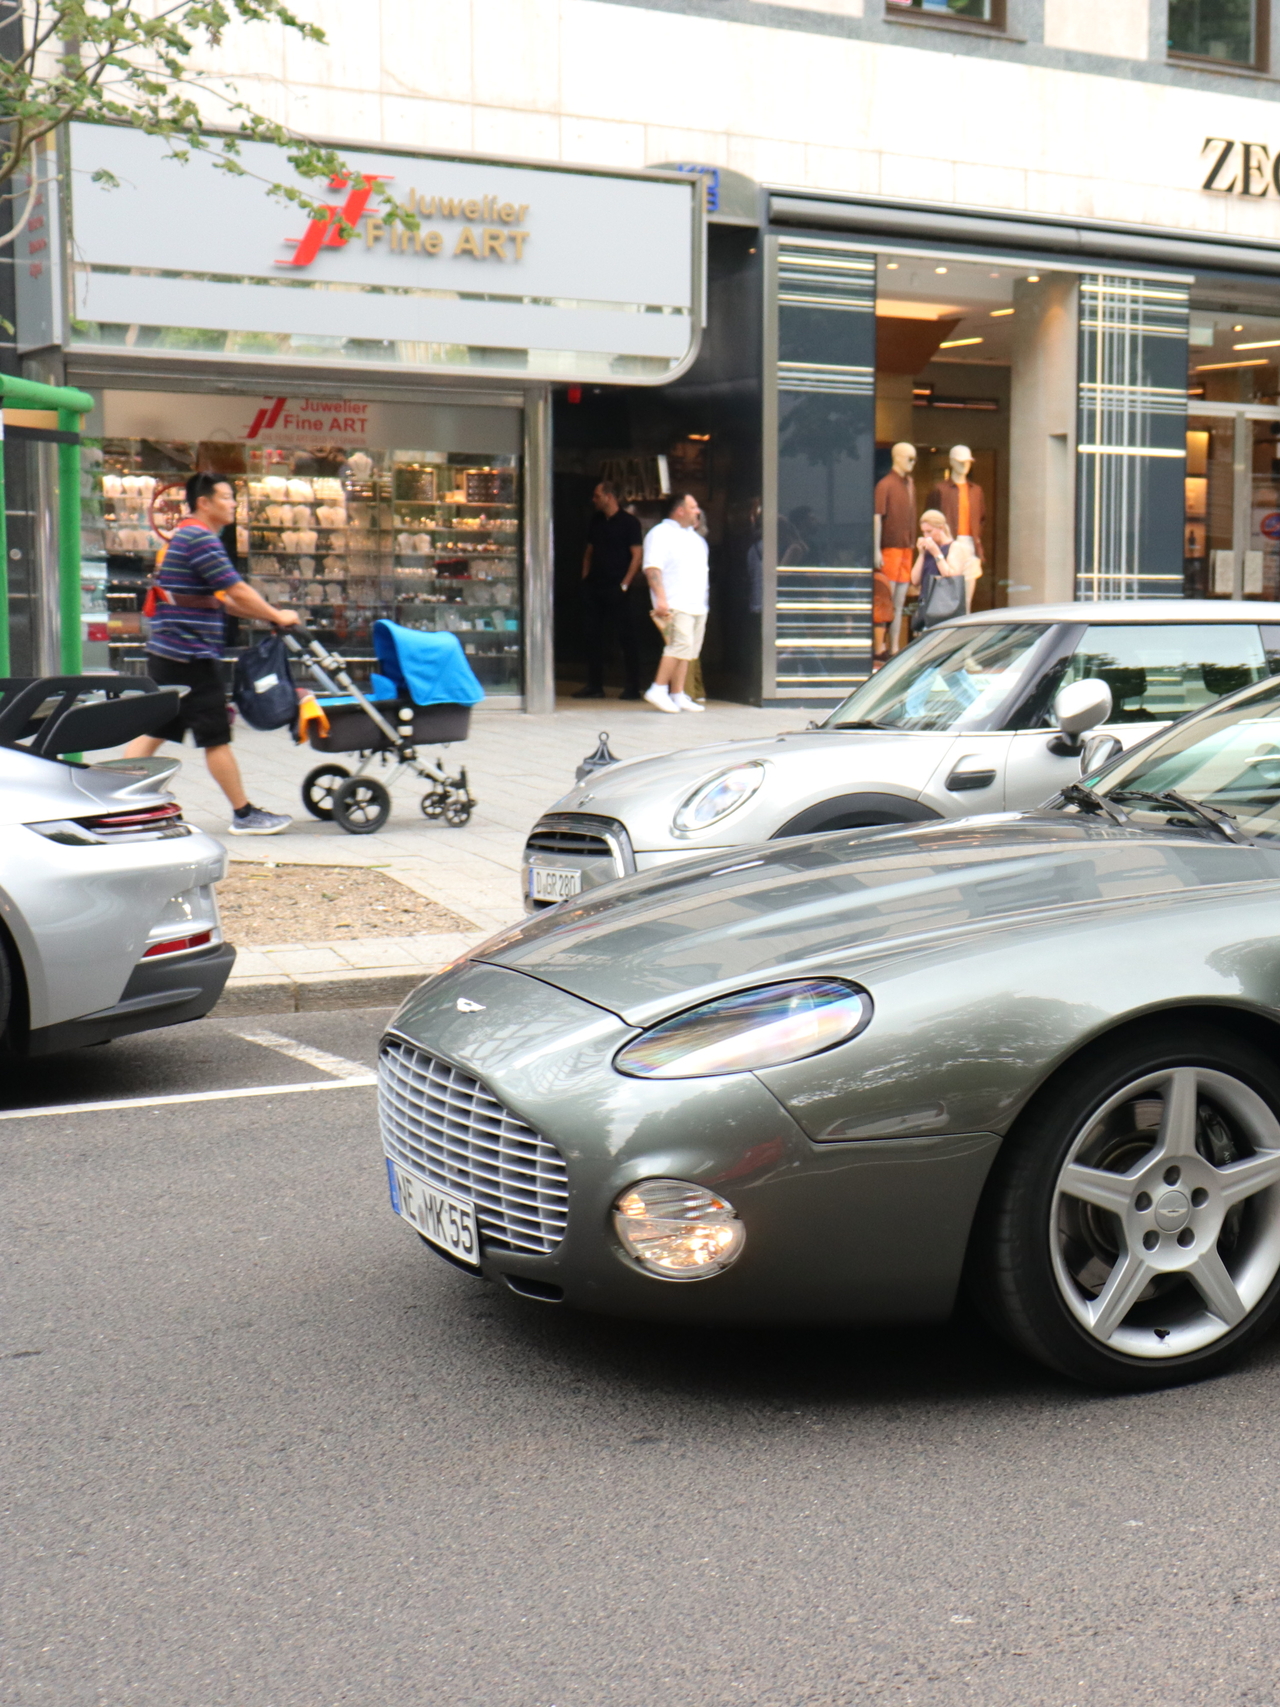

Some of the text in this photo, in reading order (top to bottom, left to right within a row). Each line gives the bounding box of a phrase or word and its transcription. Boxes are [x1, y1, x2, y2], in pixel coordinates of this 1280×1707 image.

[400, 187, 529, 222] Juwelier
[366, 218, 530, 259] Fine ART
[300, 398, 368, 414] Juwelier
[283, 414, 368, 433] Fine ART
[536, 871, 542, 894] D
[395, 1169, 474, 1255] NE MK 55
